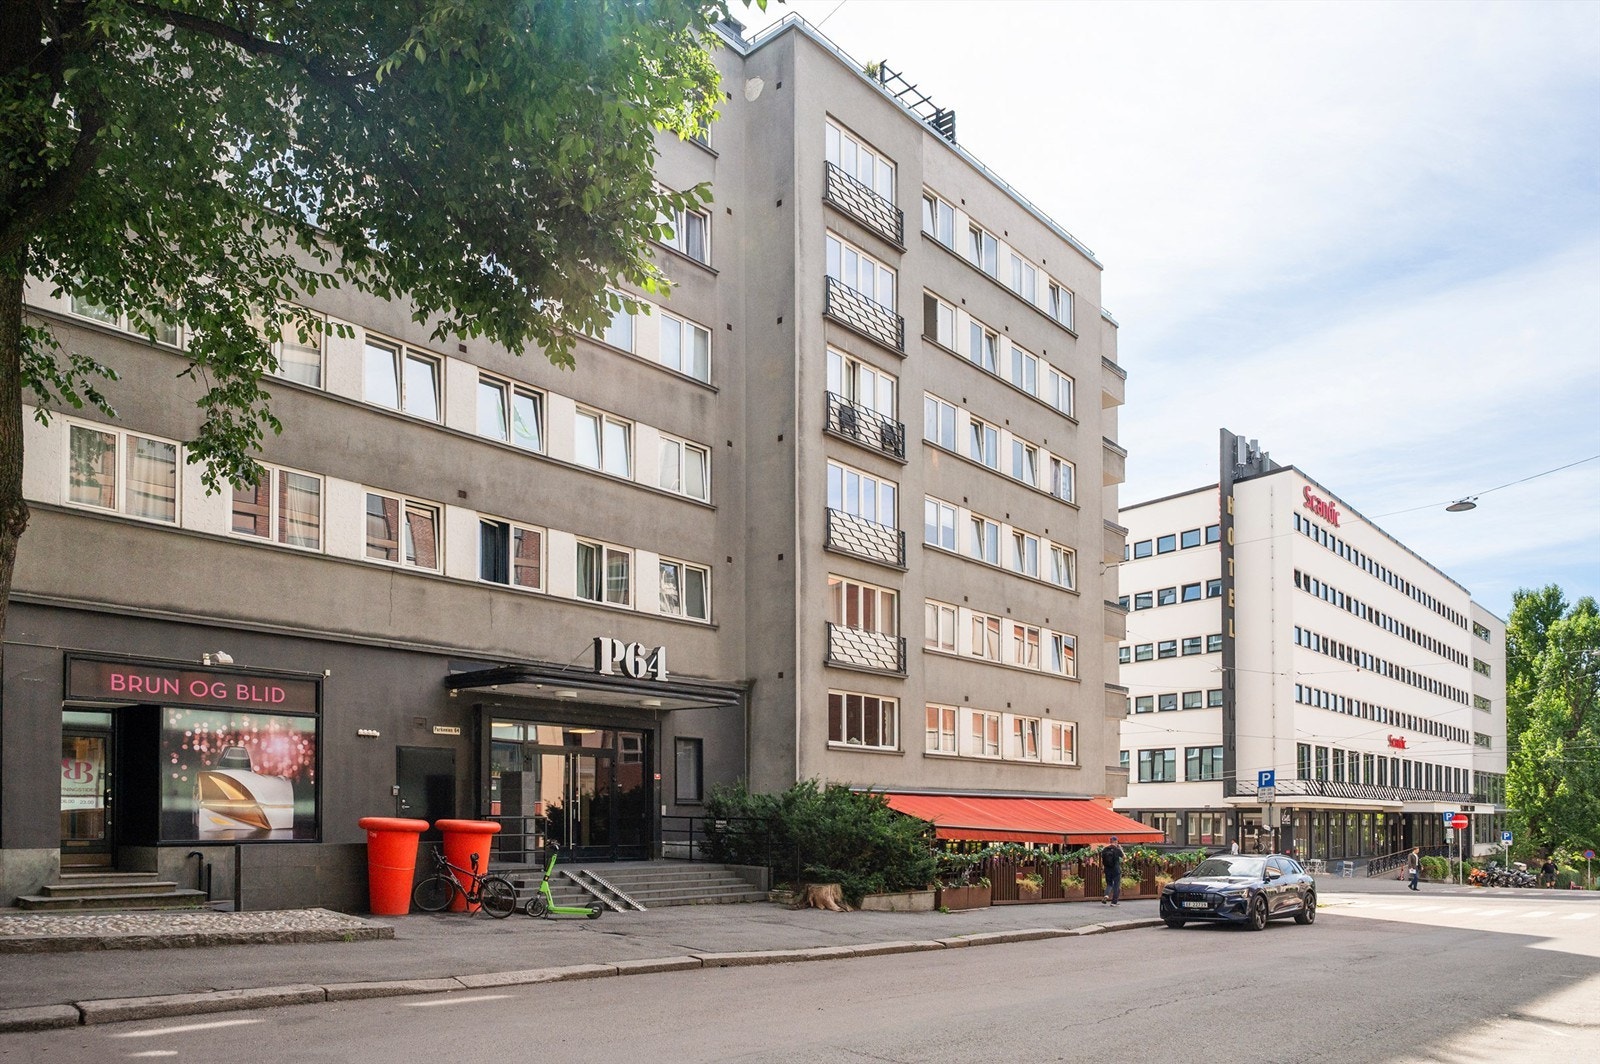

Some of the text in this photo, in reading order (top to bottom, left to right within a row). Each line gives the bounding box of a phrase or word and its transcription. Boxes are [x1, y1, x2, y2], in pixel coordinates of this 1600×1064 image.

[1303, 485, 1341, 528] Scandic
[1227, 495, 1235, 638] HOTEL
[593, 636, 670, 682] P64
[110, 673, 286, 703] BRUN OG BLID
[1261, 772, 1272, 786] P
[1445, 812, 1453, 821] P
[1503, 832, 1510, 840] P
